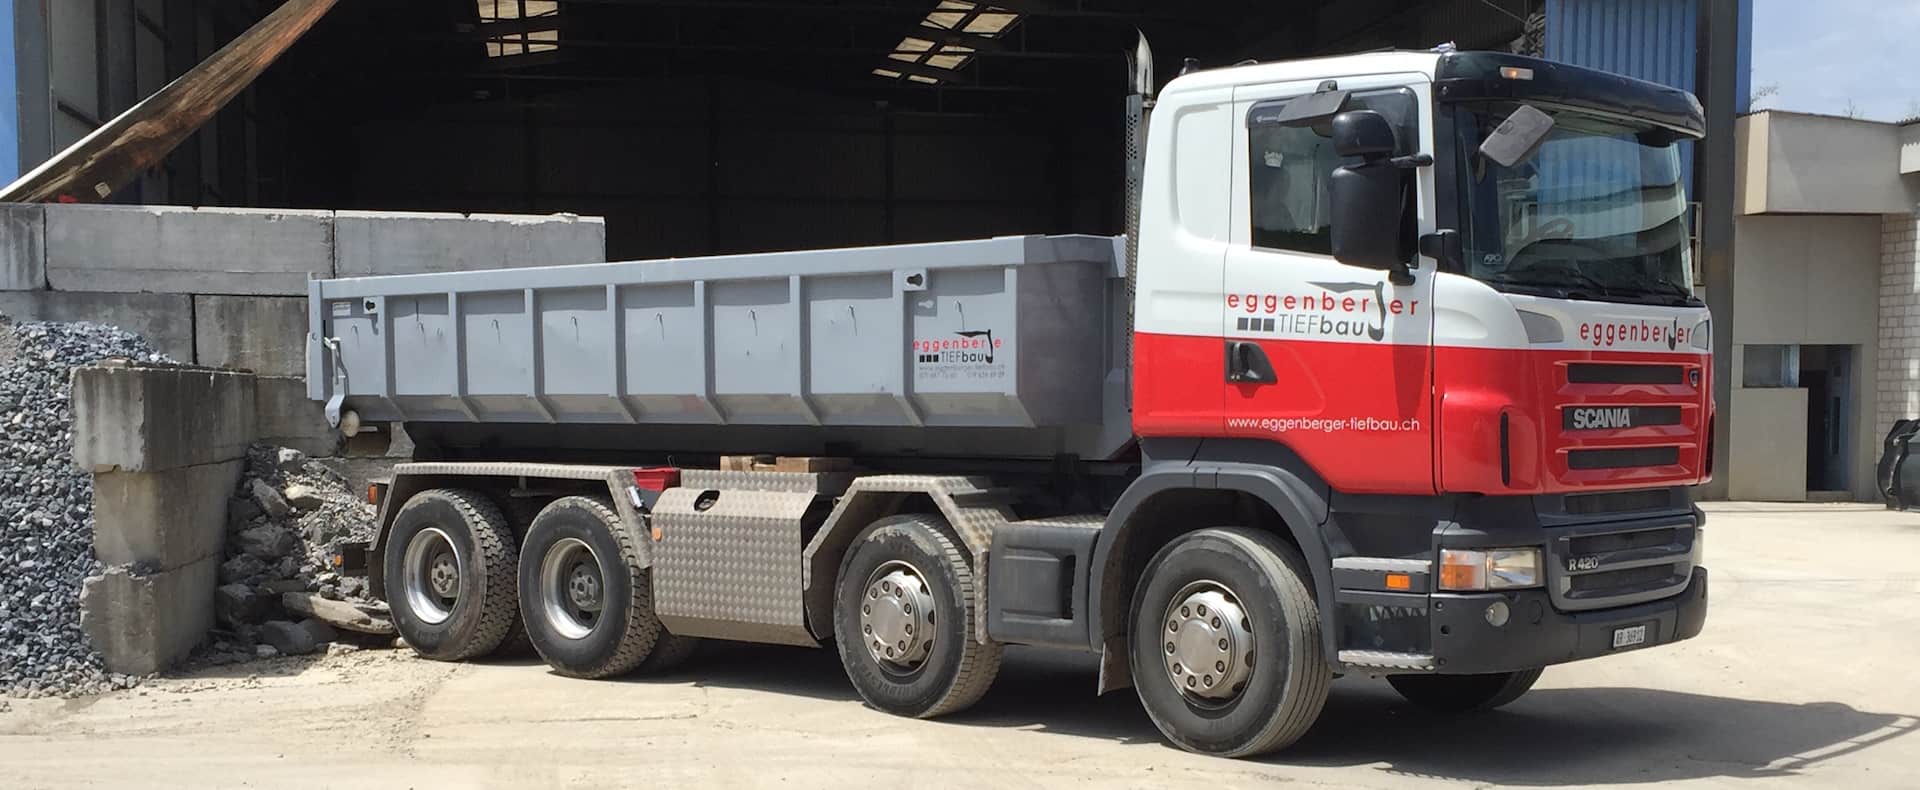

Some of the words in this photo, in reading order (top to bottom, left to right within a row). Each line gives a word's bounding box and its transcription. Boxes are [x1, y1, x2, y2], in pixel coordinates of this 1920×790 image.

[1279, 313, 1365, 337] TIEFbau
[1227, 416, 1421, 433] www.eggenberger-tiefbau.ch
[1573, 408, 1632, 429] SCANIA
[1568, 558, 1577, 571] R
[1577, 556, 1599, 570] 420
